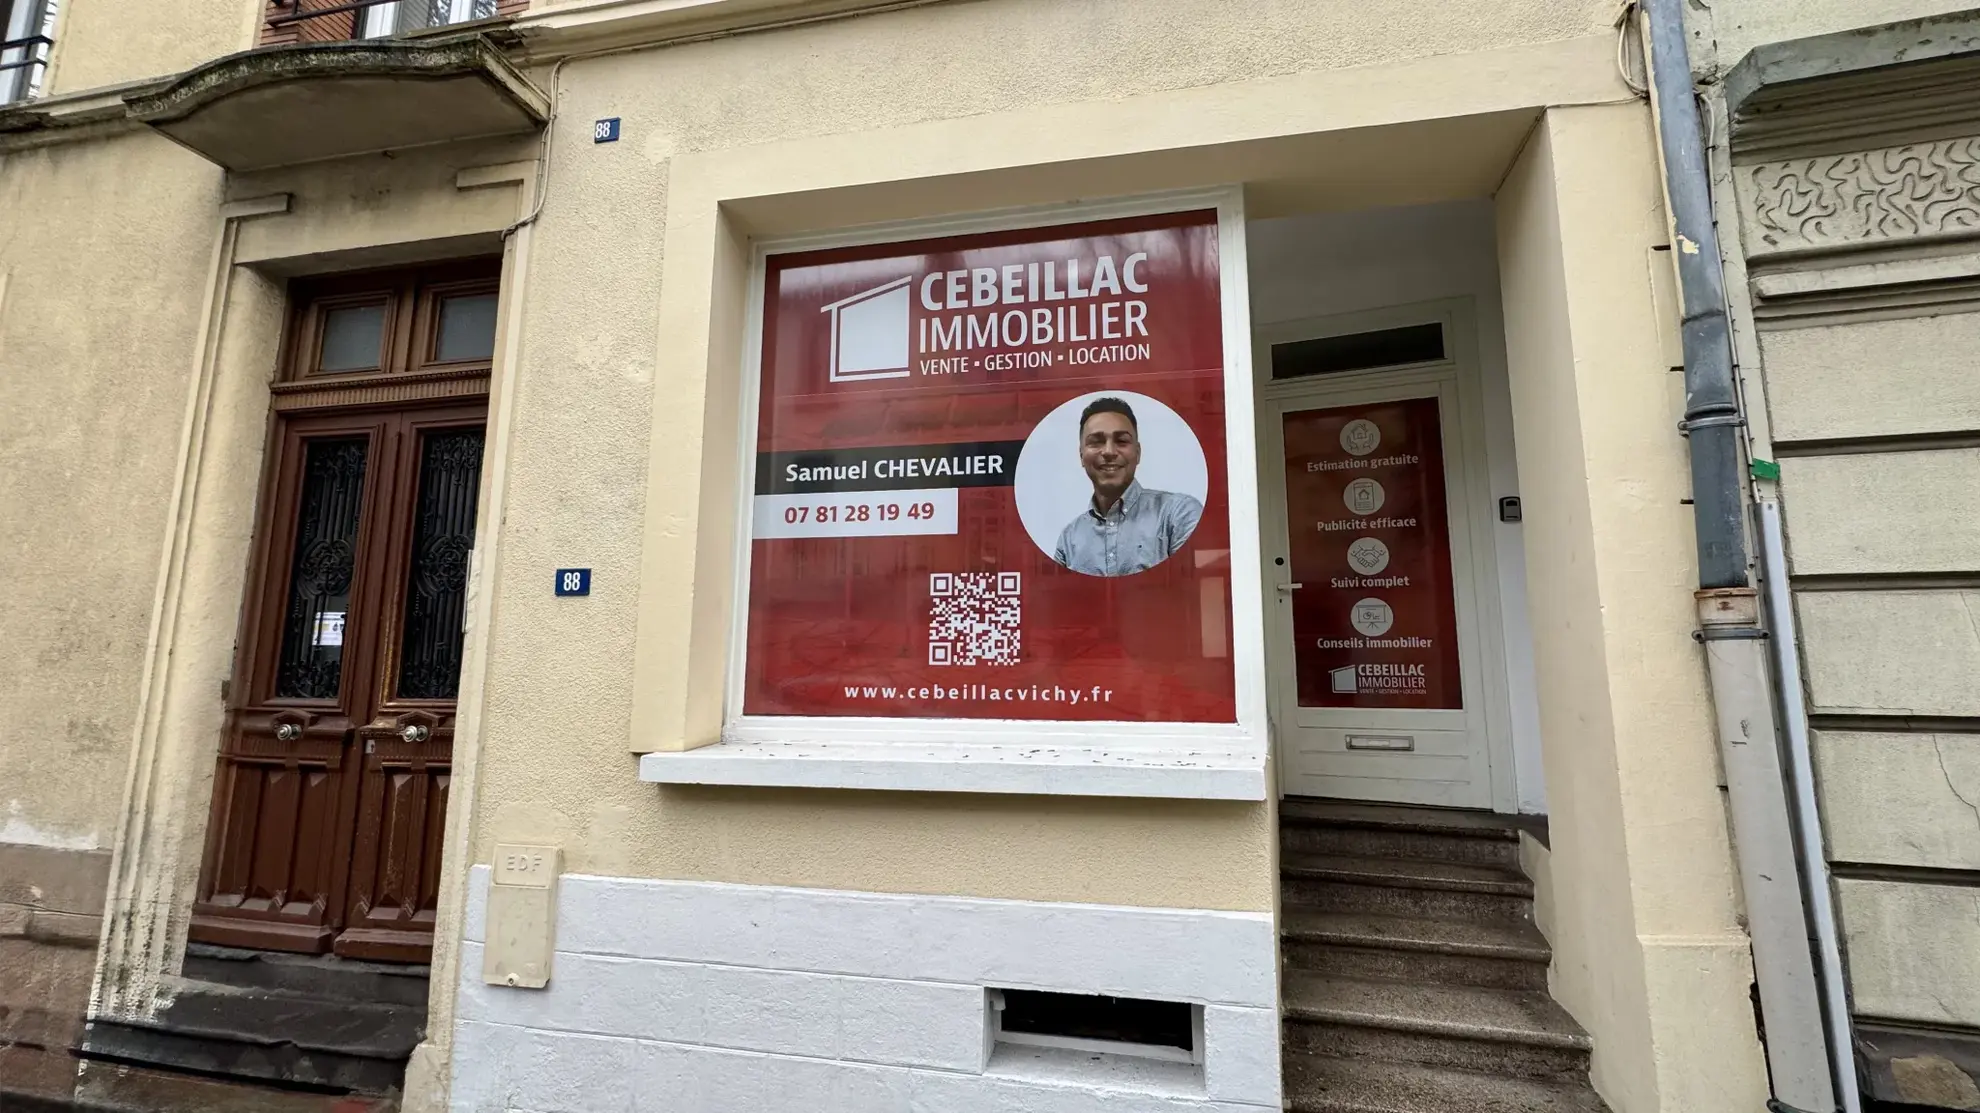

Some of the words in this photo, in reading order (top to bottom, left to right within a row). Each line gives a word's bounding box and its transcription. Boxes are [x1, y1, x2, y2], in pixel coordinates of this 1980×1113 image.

[596, 122, 610, 138] 88
[920, 252, 1149, 311] CEBEILLAC
[919, 300, 1149, 354] IMMOBILIER
[920, 356, 970, 376] VENTE
[984, 350, 1052, 371] GESTION
[1069, 343, 1150, 365] LOCATION
[785, 460, 868, 482] Samuel
[874, 455, 1004, 478] CHEVALIER
[1307, 458, 1368, 472] Estimation
[1370, 454, 1419, 469] gratuite
[784, 506, 810, 524] 07
[815, 505, 838, 523] 81
[844, 504, 870, 522] 28
[876, 503, 900, 521] 19
[907, 502, 935, 520] 49
[1317, 519, 1367, 532] Publicité
[1370, 517, 1417, 529] efficace
[564, 572, 581, 591] 88
[1331, 576, 1359, 588] Suivi
[1361, 576, 1410, 588] complet
[1317, 638, 1364, 648] Conseils
[1366, 636, 1433, 648] immobilier
[1358, 664, 1425, 676] CEBEILLAC
[1358, 677, 1426, 688] IMMOBILIER
[844, 684, 1112, 705] www.cebeillacvichy.fr
[506, 854, 542, 872] EDF
